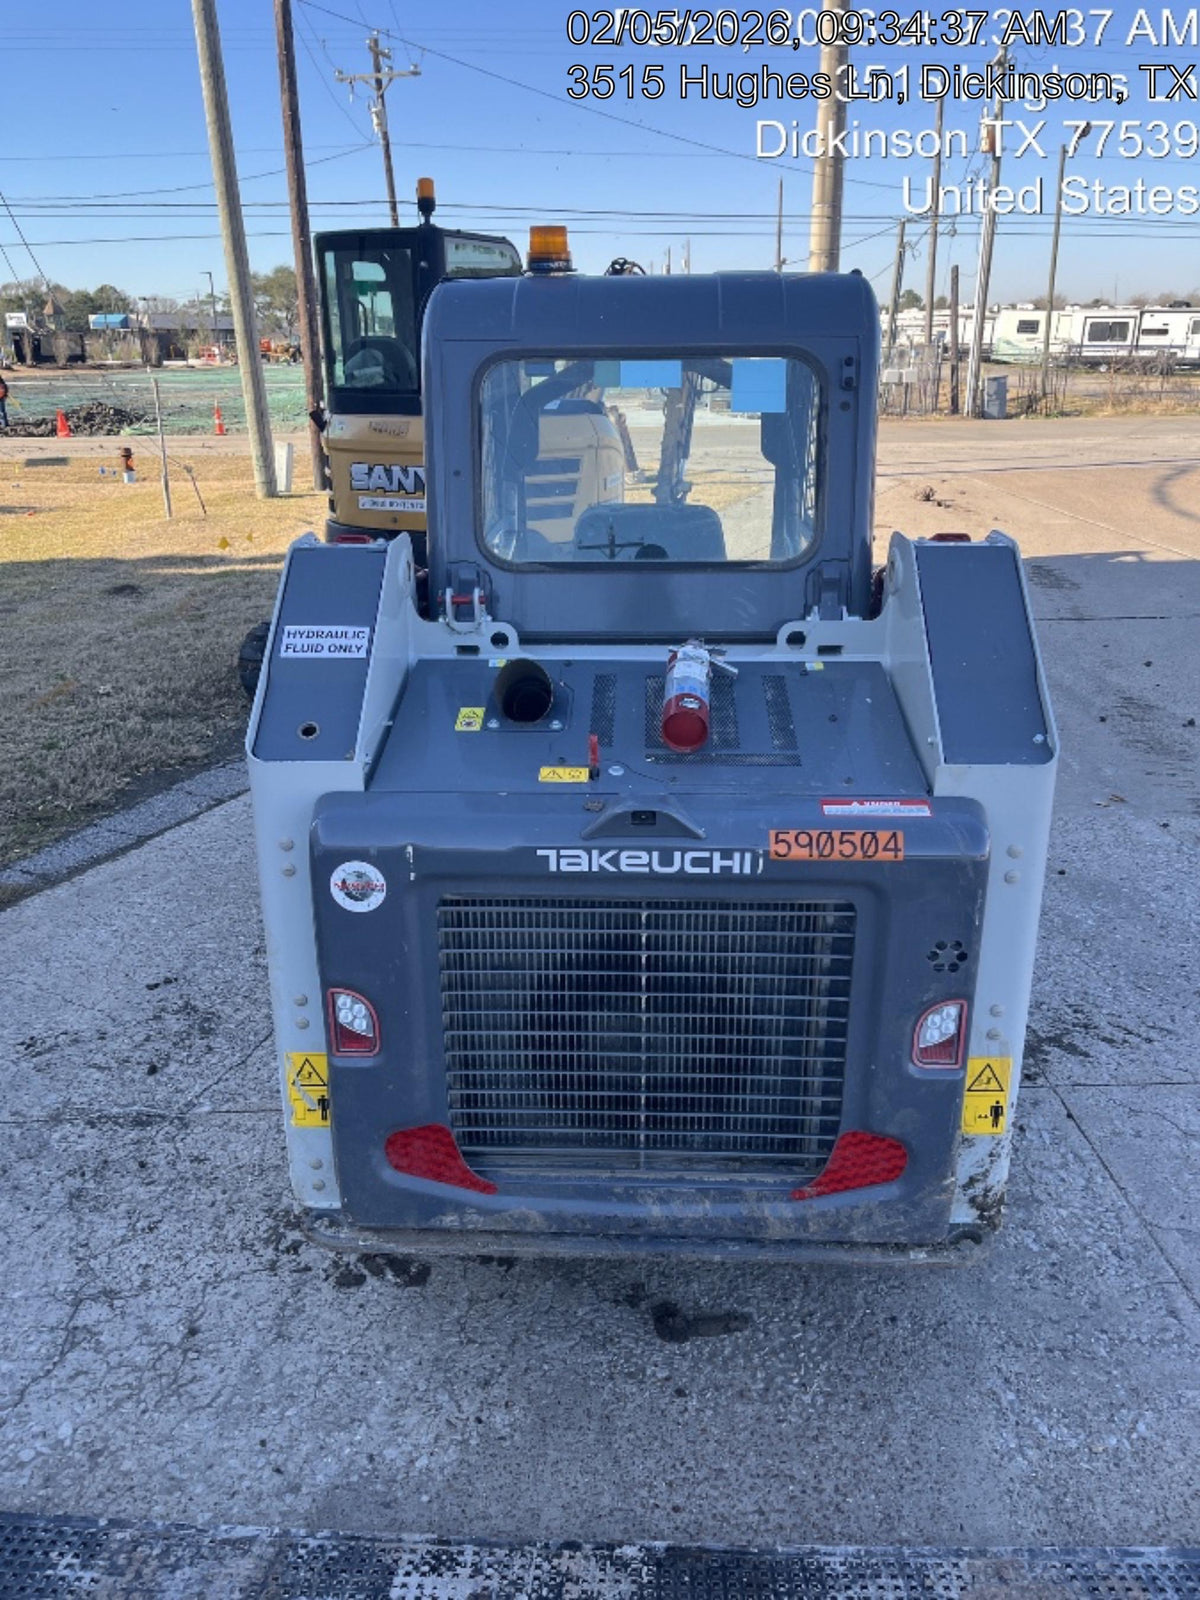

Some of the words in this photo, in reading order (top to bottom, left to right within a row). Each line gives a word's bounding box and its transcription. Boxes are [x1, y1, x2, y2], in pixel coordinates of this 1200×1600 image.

[286, 629, 366, 640] HYDRAULIC
[283, 642, 325, 654] FLUID
[327, 642, 364, 654] ONLY
[773, 831, 903, 859] 590504
